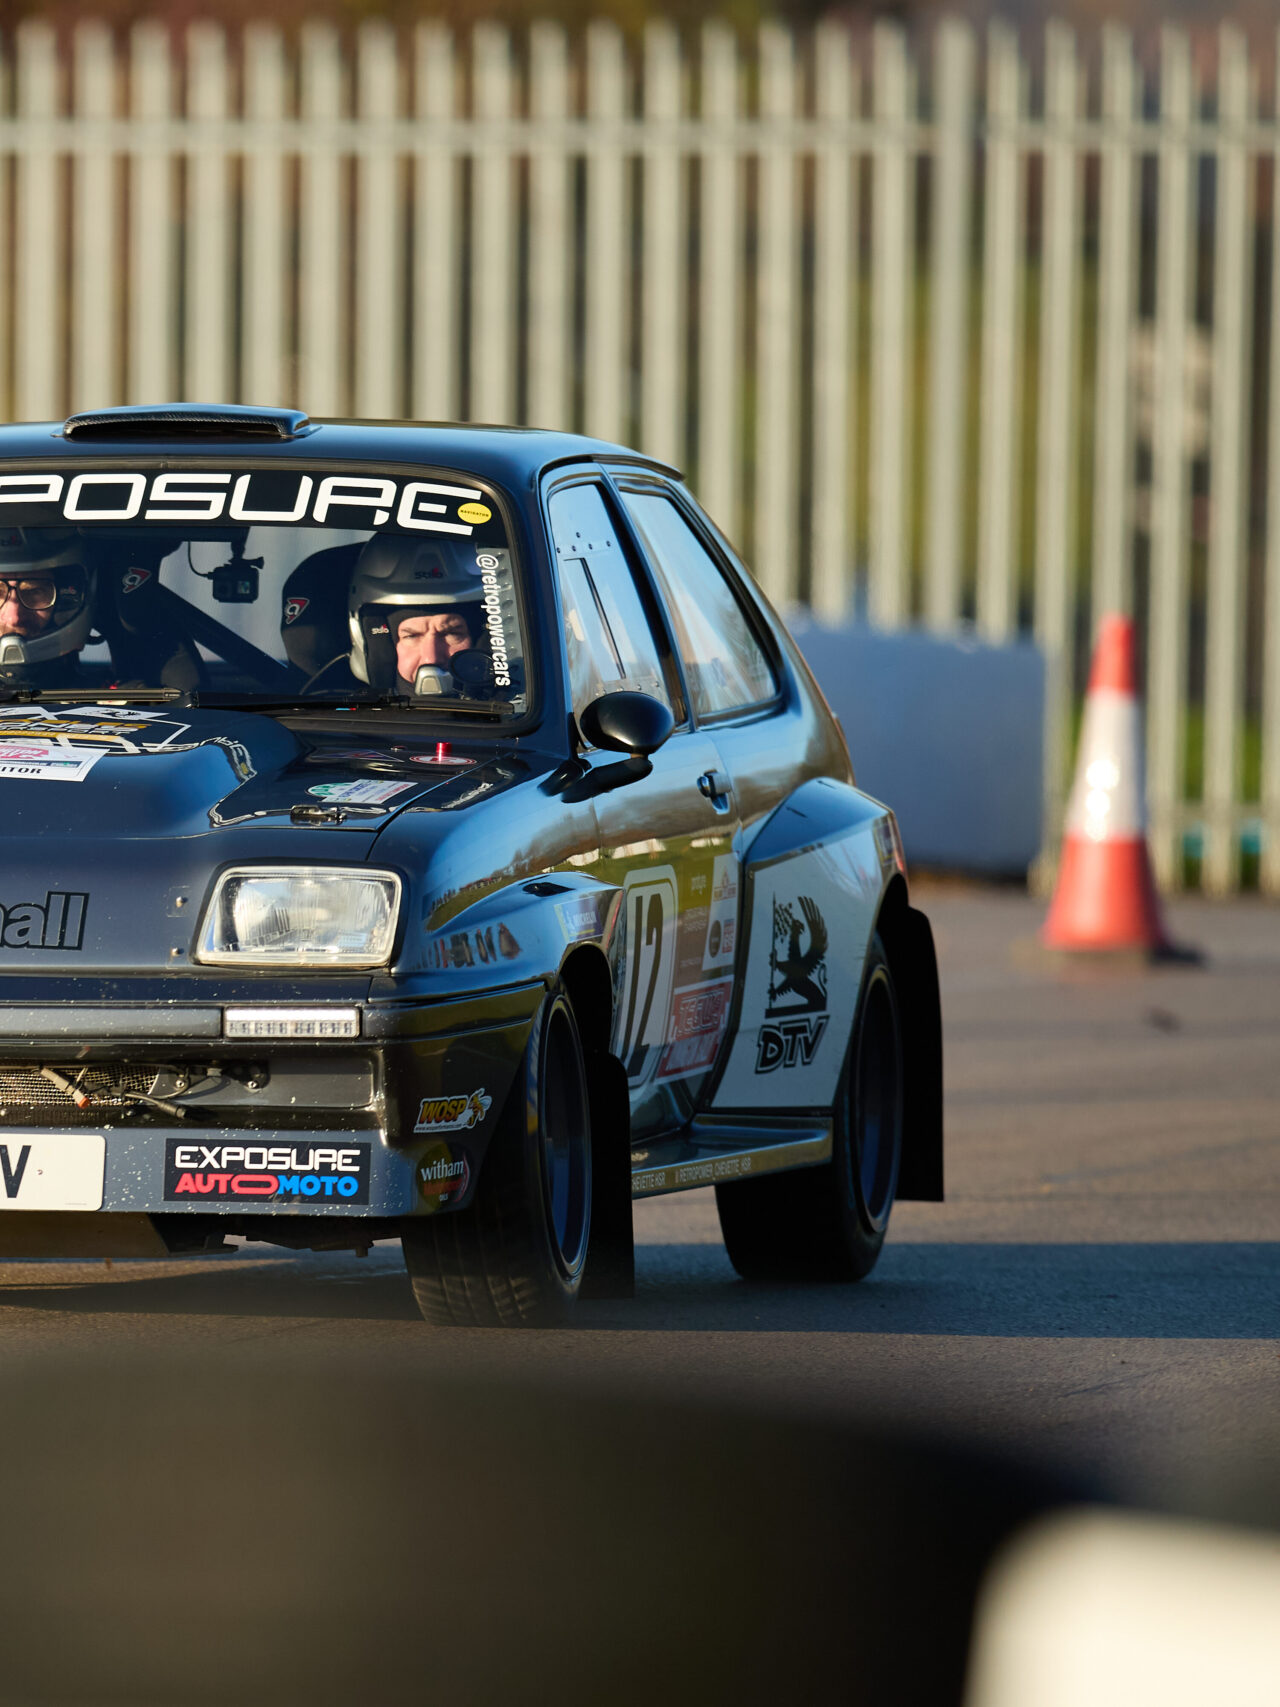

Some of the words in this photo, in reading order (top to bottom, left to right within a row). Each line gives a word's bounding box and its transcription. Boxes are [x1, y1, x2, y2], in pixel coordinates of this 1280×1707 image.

[460, 508, 490, 518] NAVIGATOR
[475, 553, 510, 687] @retropowercars
[755, 1015, 830, 1075] DTV
[419, 1099, 468, 1124] WOSP
[175, 1145, 361, 1171] EXPOSURE
[421, 1157, 465, 1182] witham
[174, 1173, 359, 1198] AUTOMOTO
